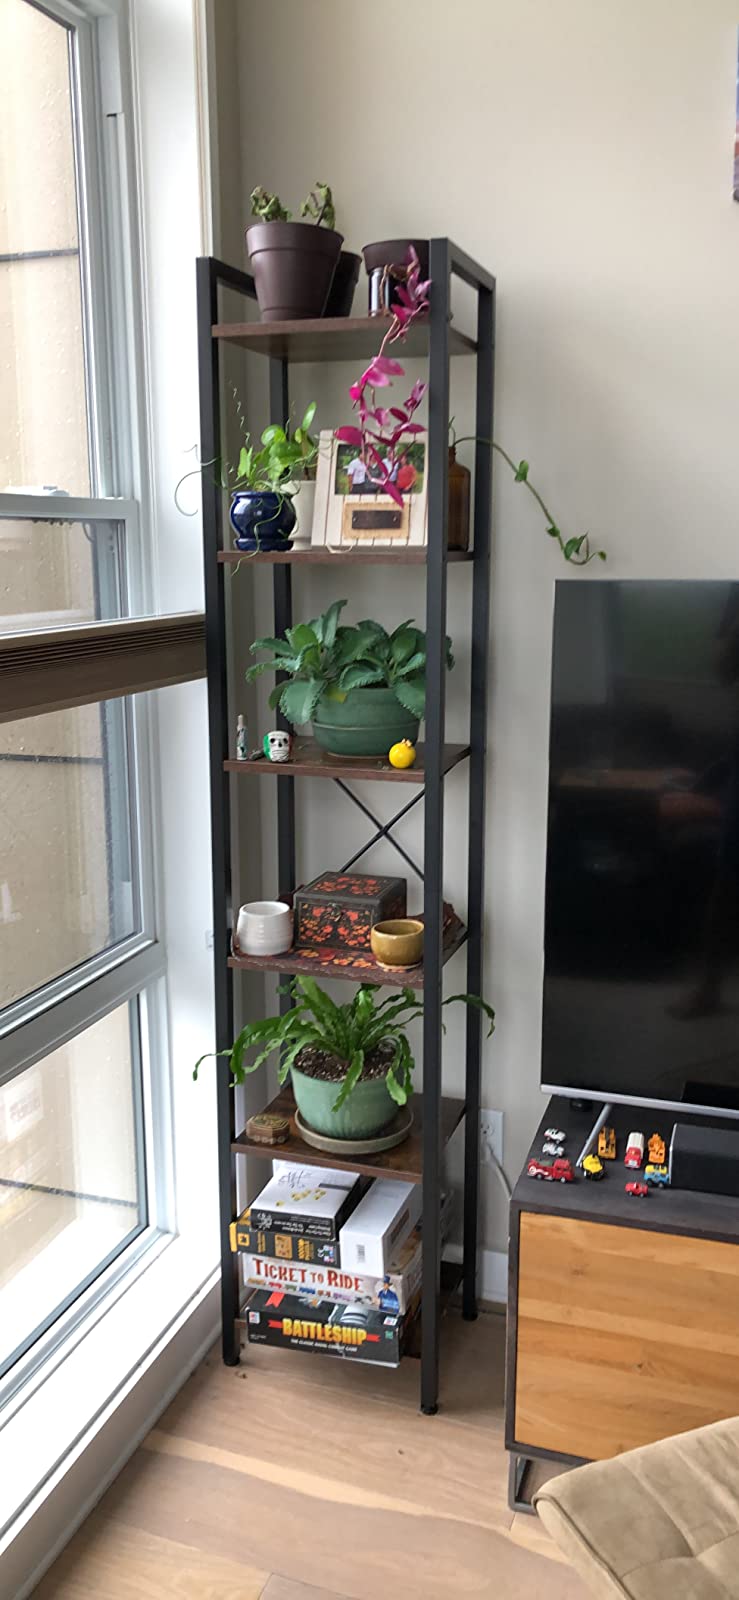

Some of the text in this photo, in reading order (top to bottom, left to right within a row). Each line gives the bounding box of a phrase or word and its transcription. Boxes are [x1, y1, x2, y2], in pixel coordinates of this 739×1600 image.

[253, 1257, 307, 1283] TICKET
[327, 1270, 363, 1293] RIDE
[282, 1318, 367, 1345] BATTLESHIP
